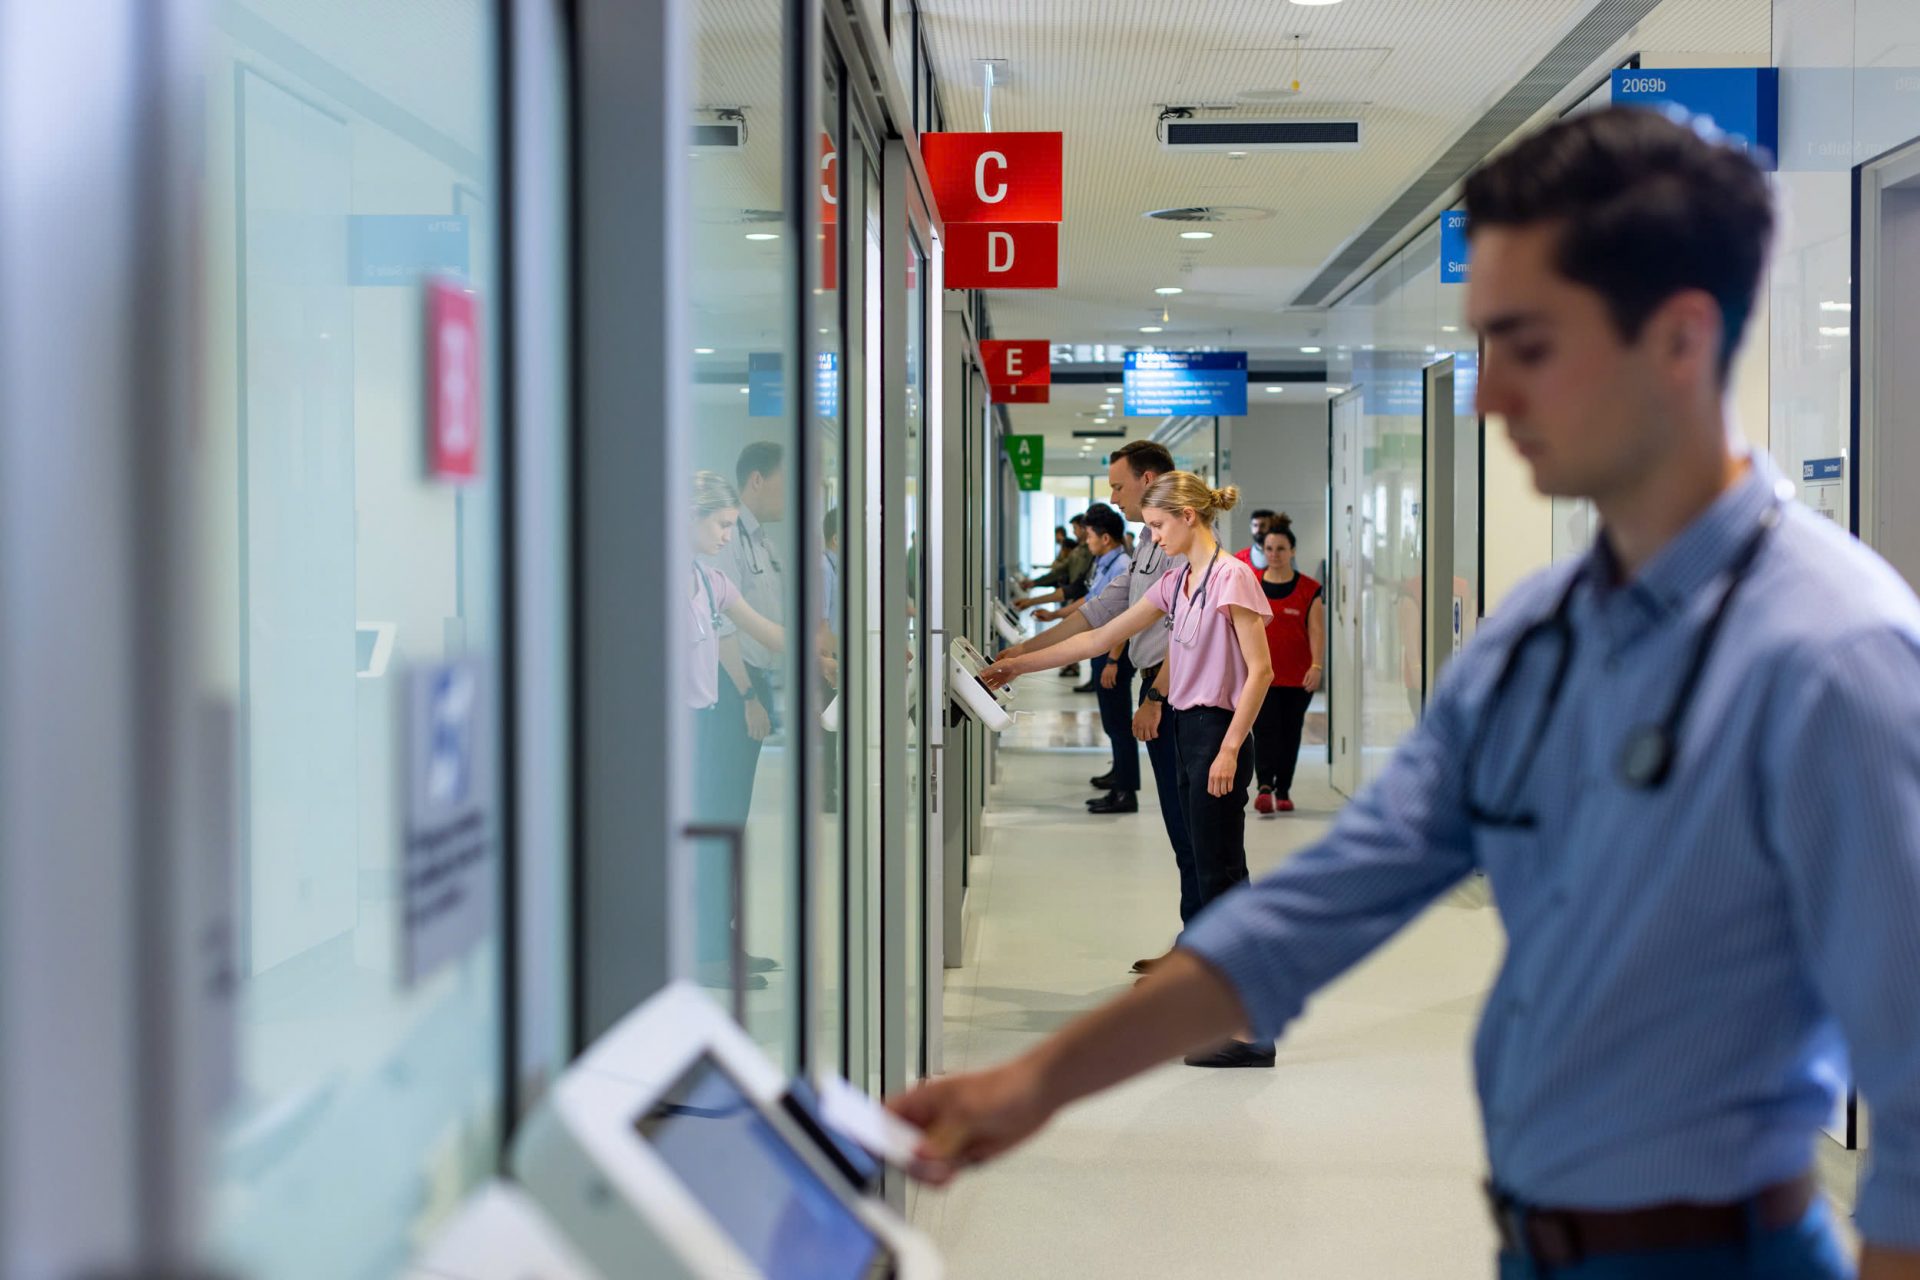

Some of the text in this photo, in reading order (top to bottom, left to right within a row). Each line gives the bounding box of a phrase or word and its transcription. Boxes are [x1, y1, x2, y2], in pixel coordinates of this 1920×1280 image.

[1622, 78, 1666, 93] 2069b
[974, 151, 1008, 203] C
[1448, 217, 1469, 228] 207
[988, 231, 1015, 272] D
[1006, 348, 1023, 376] E
[1019, 439, 1030, 454] A
